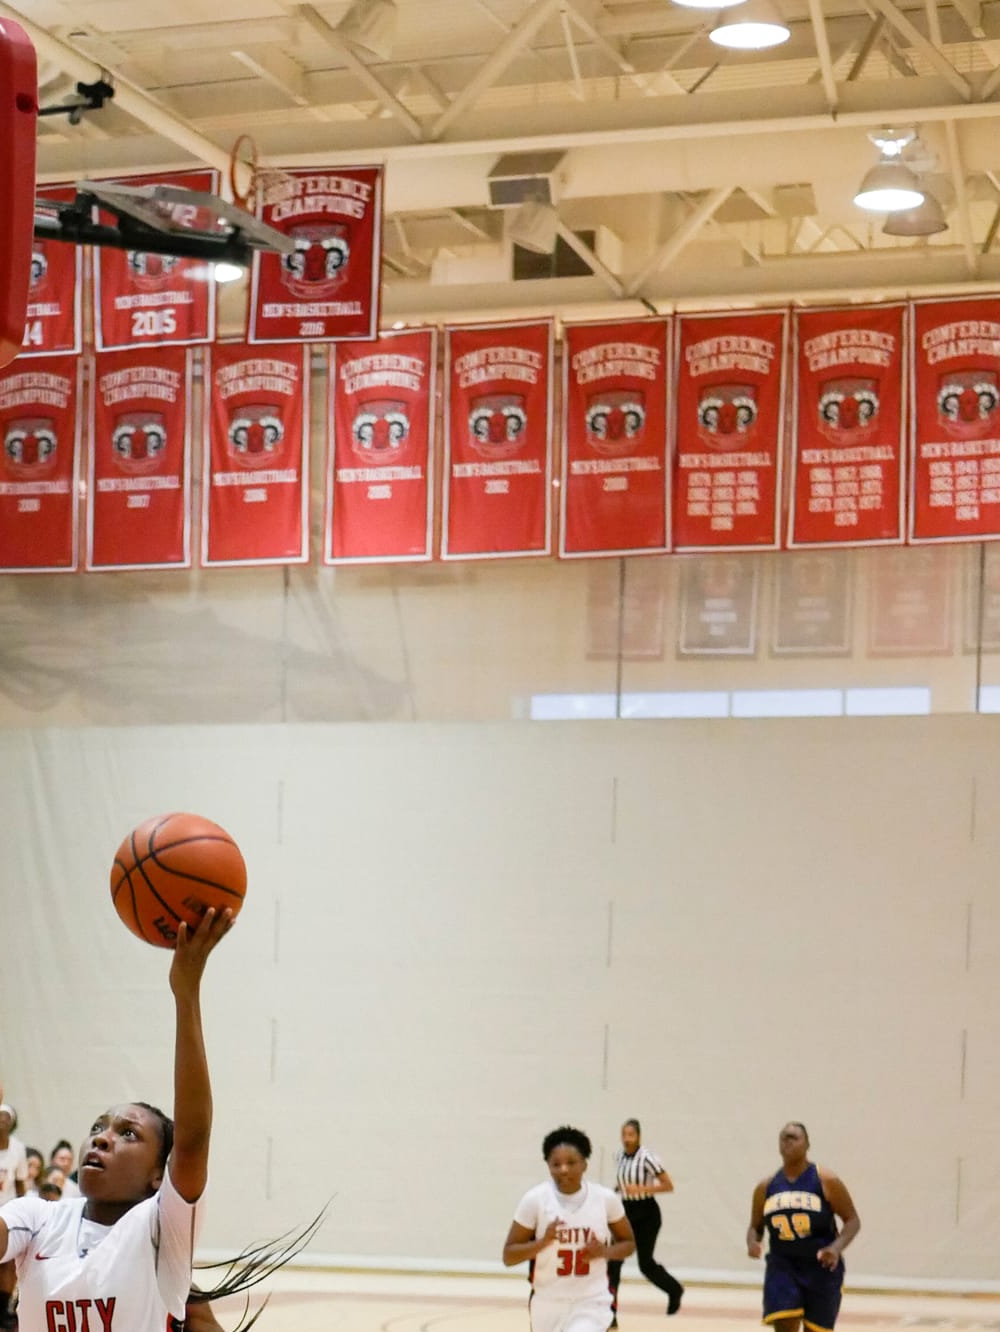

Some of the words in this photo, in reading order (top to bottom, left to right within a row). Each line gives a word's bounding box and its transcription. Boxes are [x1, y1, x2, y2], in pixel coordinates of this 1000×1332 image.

[271, 195, 366, 222] CHAMPIONS
[131, 308, 177, 337] 2015
[922, 320, 1000, 350] CONFEREN
[685, 336, 776, 362] CONFERENCE
[804, 329, 895, 357] CONFERENCE
[928, 338, 1000, 365] CHAMPION
[340, 354, 425, 380] CONFERENCE
[455, 346, 543, 374] CONFERENCE
[572, 343, 661, 370] CONFERENCE
[690, 353, 770, 377] CHAMPIONS
[809, 347, 890, 372] CHAMPIONS
[100, 366, 181, 392] CONFERENCE
[216, 359, 298, 385] CONFERENCE
[345, 370, 420, 394] CHAMPIONS
[459, 364, 538, 388] CHAMPIONS
[577, 360, 656, 384] CHAMPIONS
[104, 383, 176, 406] CHAMPIONS
[221, 375, 294, 399] CHAMPIONS
[557, 1227, 591, 1244] CITY
